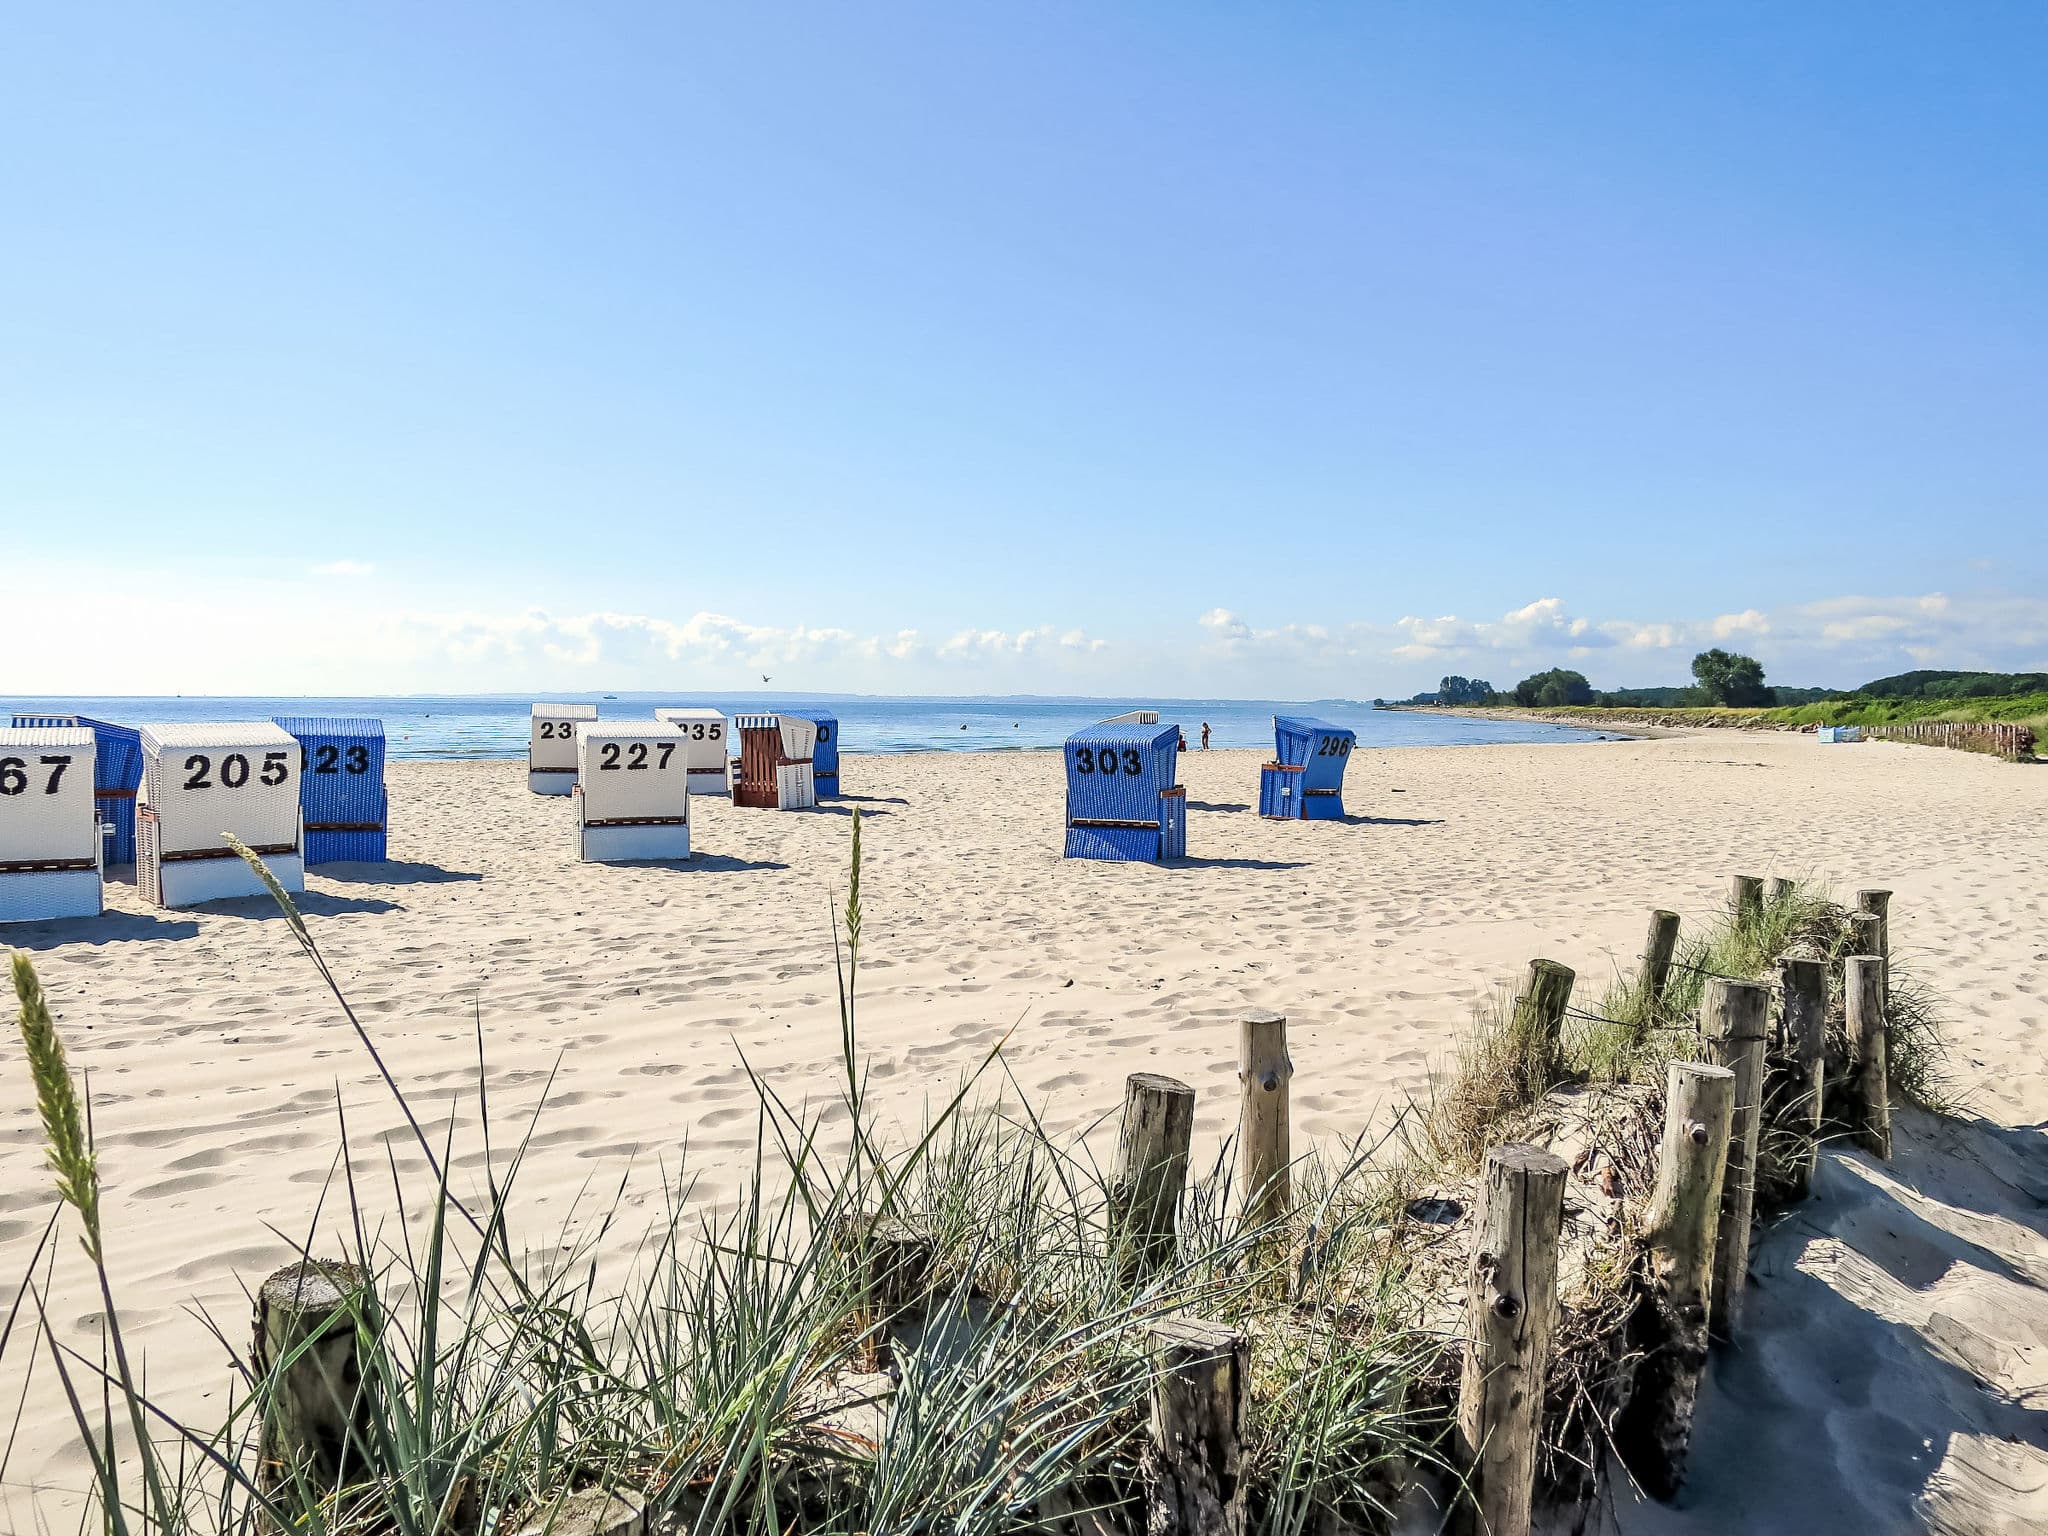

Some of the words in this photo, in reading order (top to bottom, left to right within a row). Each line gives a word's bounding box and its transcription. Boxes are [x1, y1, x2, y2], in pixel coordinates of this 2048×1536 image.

[540, 721, 577, 740] 23
[600, 742, 676, 771] 227
[1075, 747, 1142, 776] 303
[0, 755, 72, 796] 67
[183, 752, 288, 791] 205
